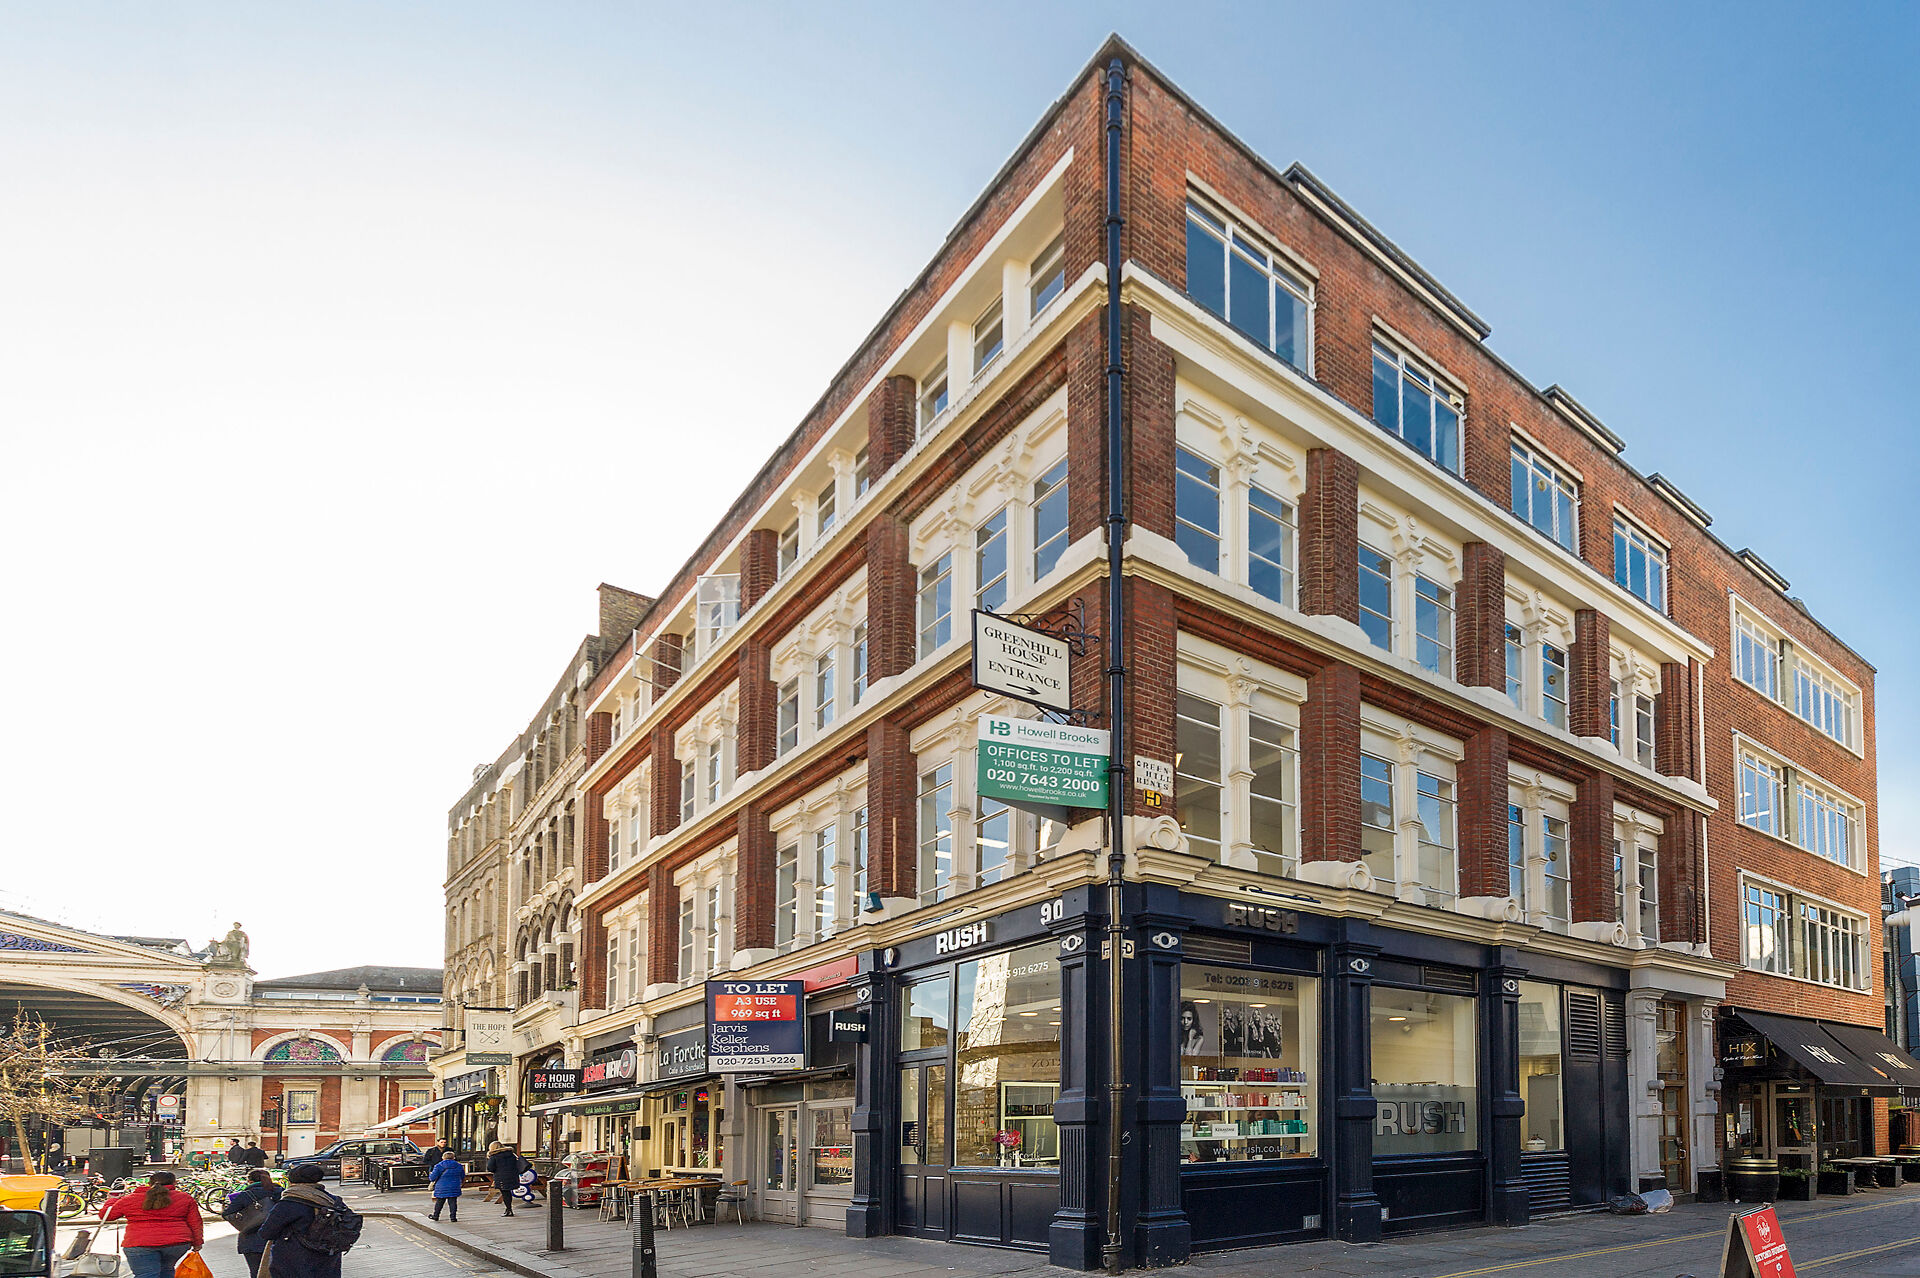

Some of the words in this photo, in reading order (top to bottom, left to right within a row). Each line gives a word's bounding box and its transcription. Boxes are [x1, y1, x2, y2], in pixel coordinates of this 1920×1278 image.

[984, 626, 1062, 659] GREENHILL
[1002, 642, 1047, 665] HOUSE
[988, 660, 1061, 690] ENTRANCE
[1017, 725, 1056, 739] Howell
[1060, 731, 1100, 745] Brooks
[987, 745, 1048, 763] OFFICES
[1051, 753, 1071, 765] TO
[1074, 757, 1101, 768] LET
[993, 759, 1015, 768] 1,100
[1040, 764, 1048, 772] to
[1050, 766, 1072, 775] 2,200
[987, 768, 1016, 782] 020
[1020, 773, 1058, 787] 7643
[1062, 778, 1100, 792] 2000
[1040, 899, 1063, 925] 90
[1224, 903, 1298, 934] RUSH
[936, 920, 987, 955] RUSH
[1012, 966, 1026, 977] 912
[1027, 961, 1049, 973] 6275
[724, 983, 751, 994] TO
[755, 983, 788, 994] LET
[1204, 972, 1222, 984] Tel:
[1271, 980, 1294, 991] 6275
[735, 997, 752, 1006] A3
[755, 997, 777, 1006] USE
[731, 1009, 753, 1018] 969
[755, 1010, 770, 1019] sq
[772, 1009, 781, 1018] ft
[488, 1023, 507, 1031] HOPE
[711, 1023, 748, 1035] Jarvis
[835, 1022, 866, 1032] RUSH
[711, 1034, 749, 1044] Keller
[711, 1043, 770, 1055] Stephens
[1729, 1042, 1757, 1054] HIX
[1800, 1044, 1846, 1065] HIX
[659, 1050, 670, 1067] La
[717, 1056, 796, 1066] 020-7251-9226
[534, 1074, 547, 1083] 24
[549, 1074, 576, 1083] HOUR
[1376, 1101, 1465, 1136] RUSH
[1213, 1144, 1288, 1156] www.rush.co.uk
